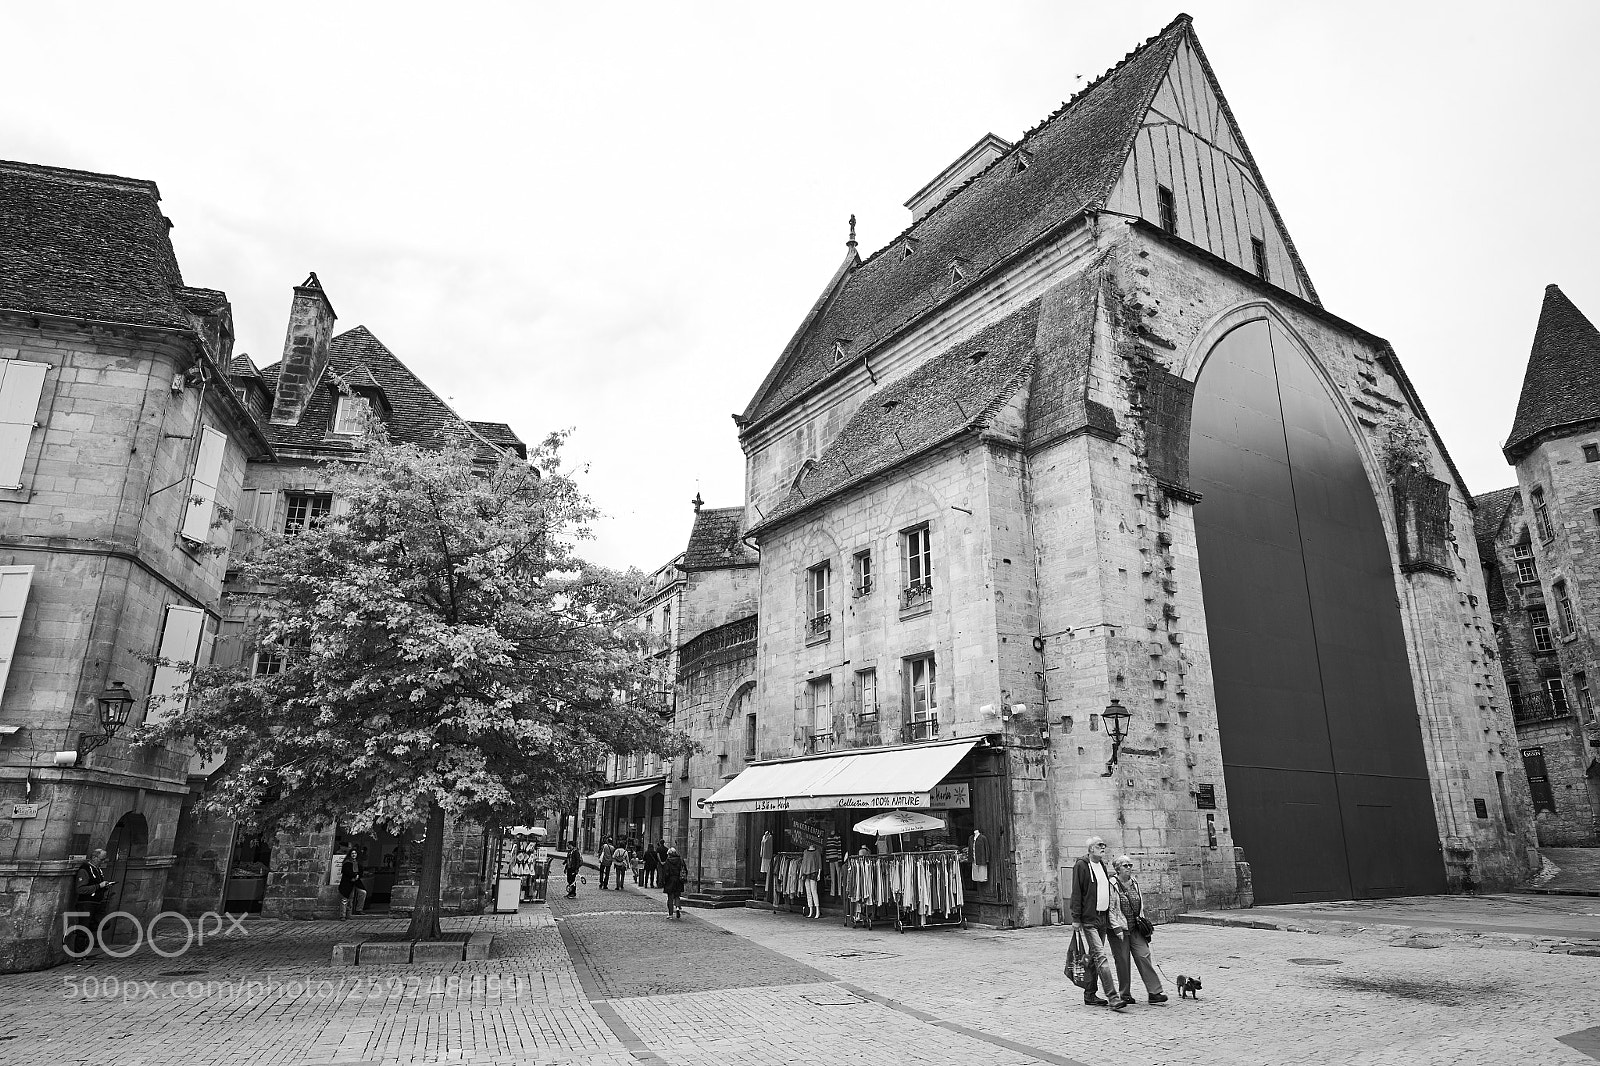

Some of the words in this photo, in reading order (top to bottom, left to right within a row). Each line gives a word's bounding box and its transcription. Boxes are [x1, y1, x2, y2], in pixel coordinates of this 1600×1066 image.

[838, 798, 870, 807] Collection
[871, 796, 890, 807] 100%
[891, 795, 920, 806] NATURE
